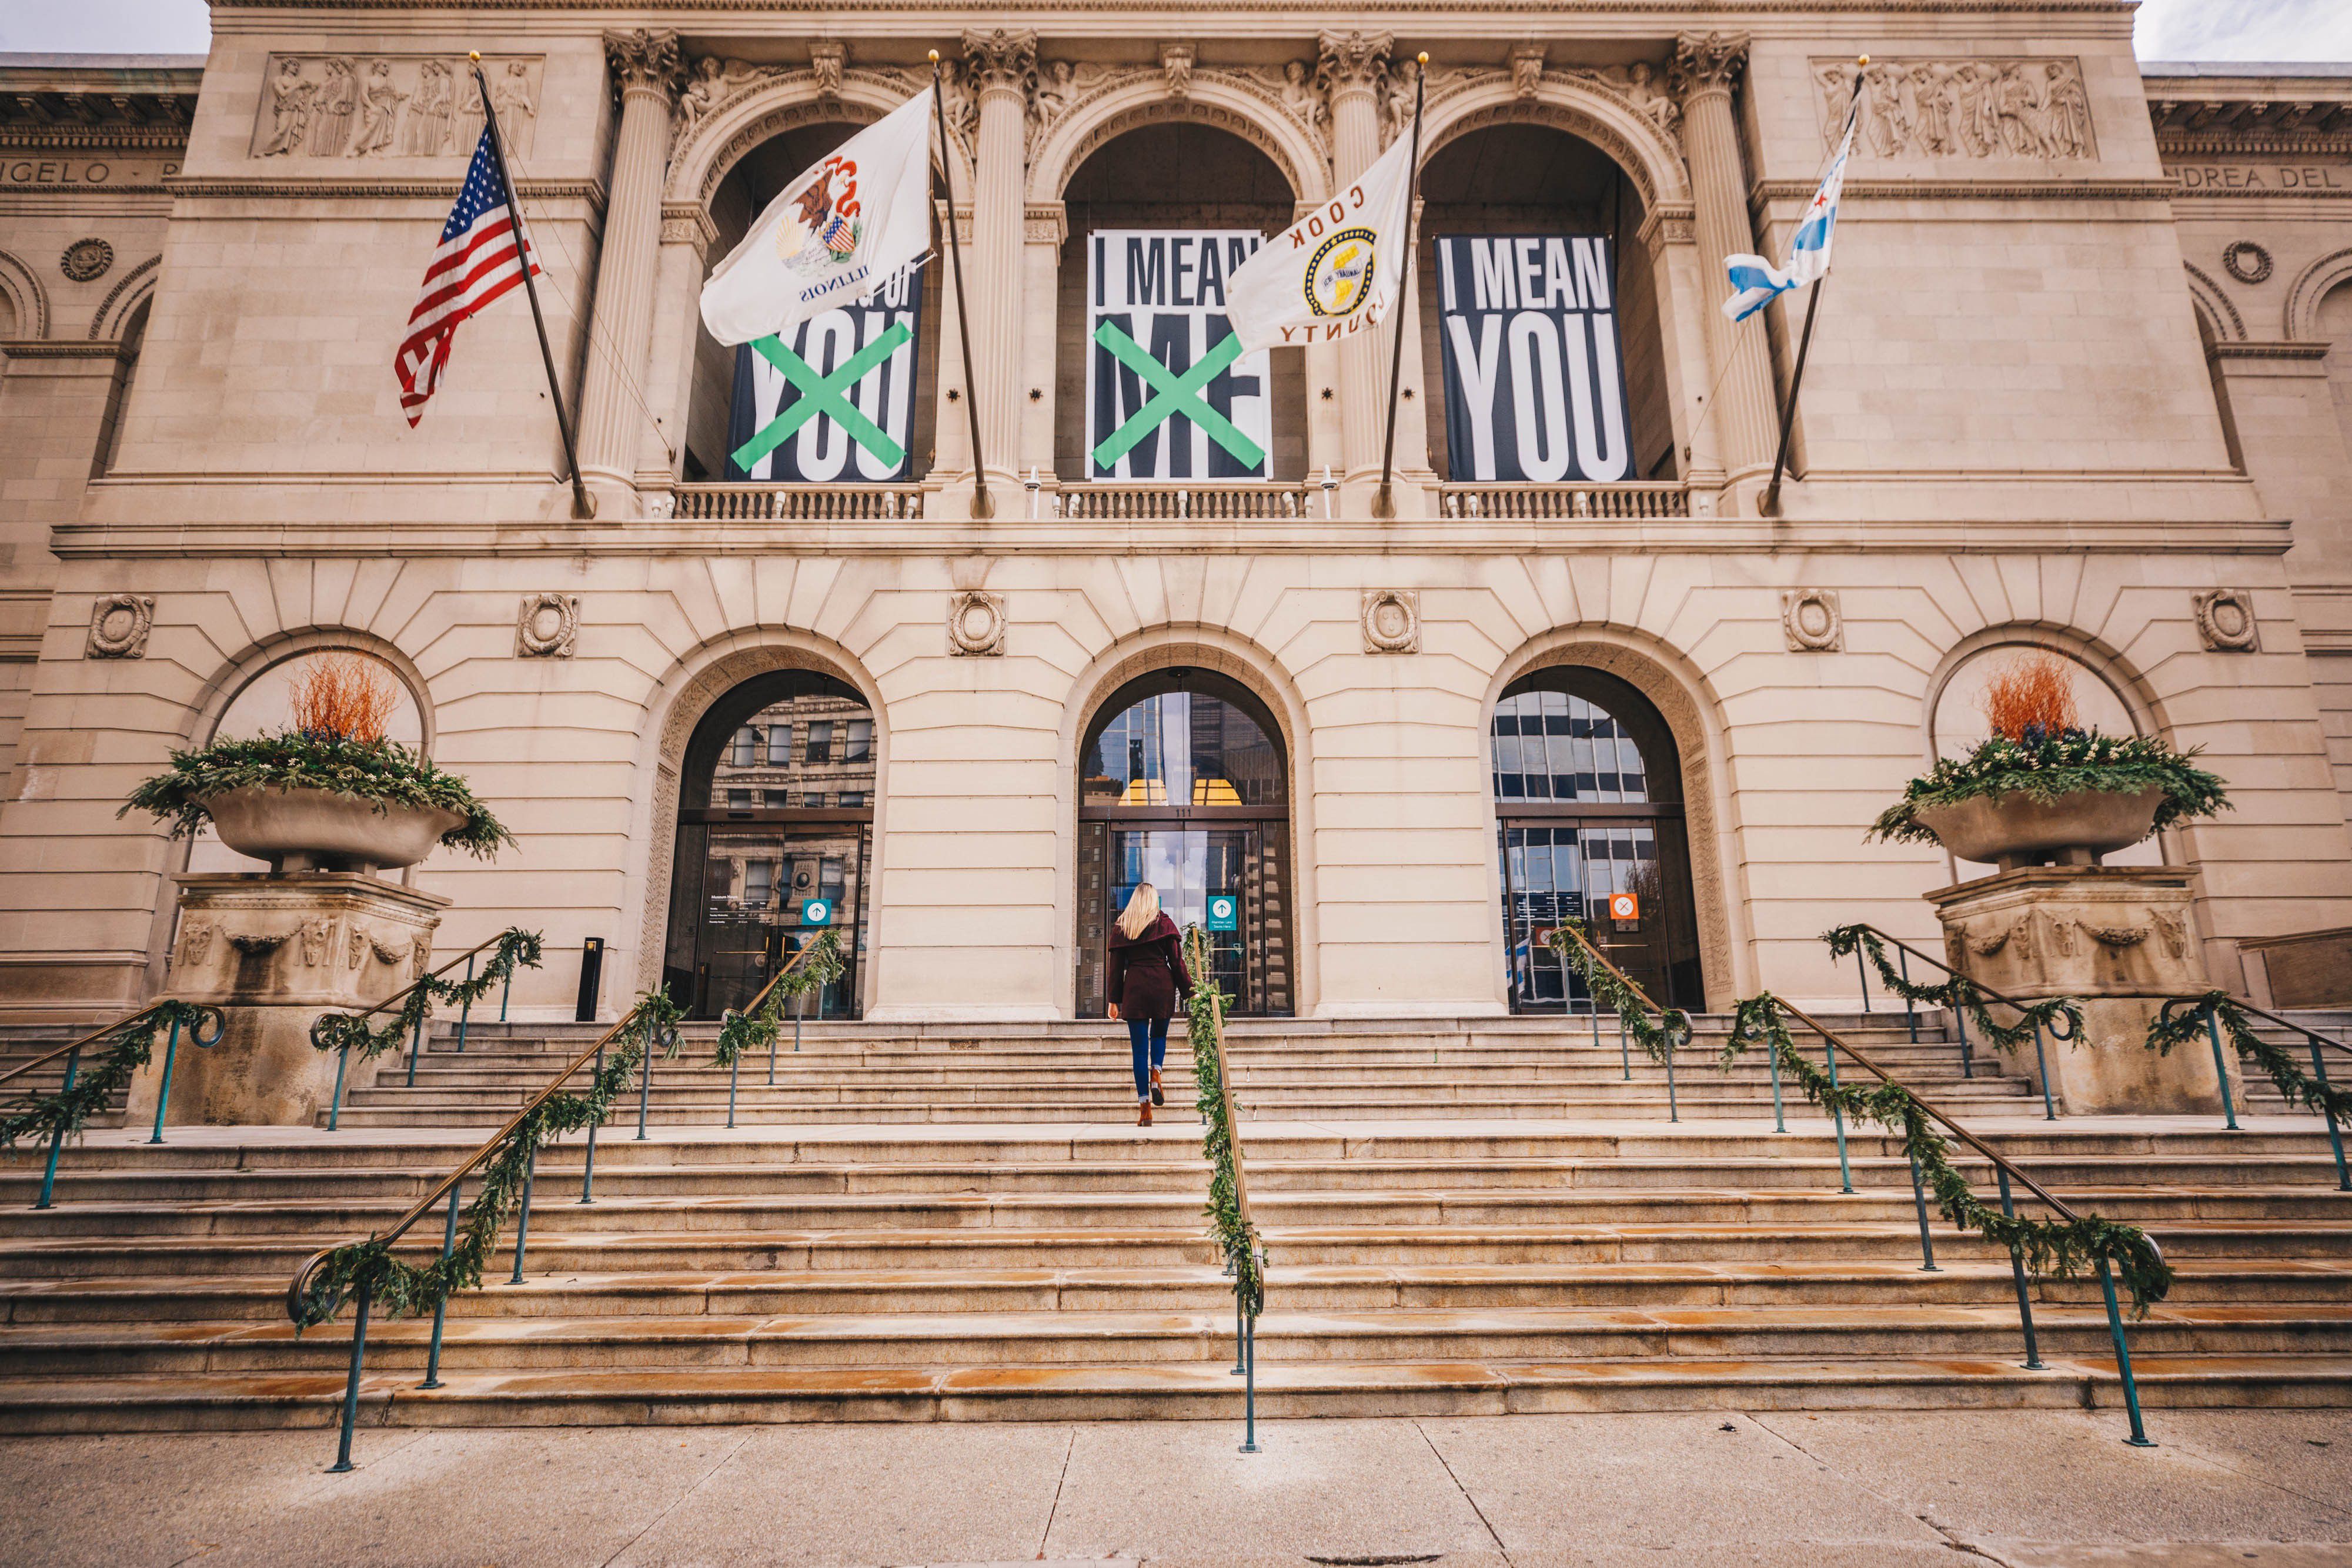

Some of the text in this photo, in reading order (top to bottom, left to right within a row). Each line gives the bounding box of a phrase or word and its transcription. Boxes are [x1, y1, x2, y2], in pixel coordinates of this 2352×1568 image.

[2280, 168, 2342, 188] DEL
[1095, 237, 1105, 306] I
[1439, 238, 1611, 310] I MEAN
[751, 309, 914, 482] YOU
[1093, 313, 1265, 478] ME
[1446, 311, 1628, 482] YOU
[1176, 808, 1191, 817] 111
